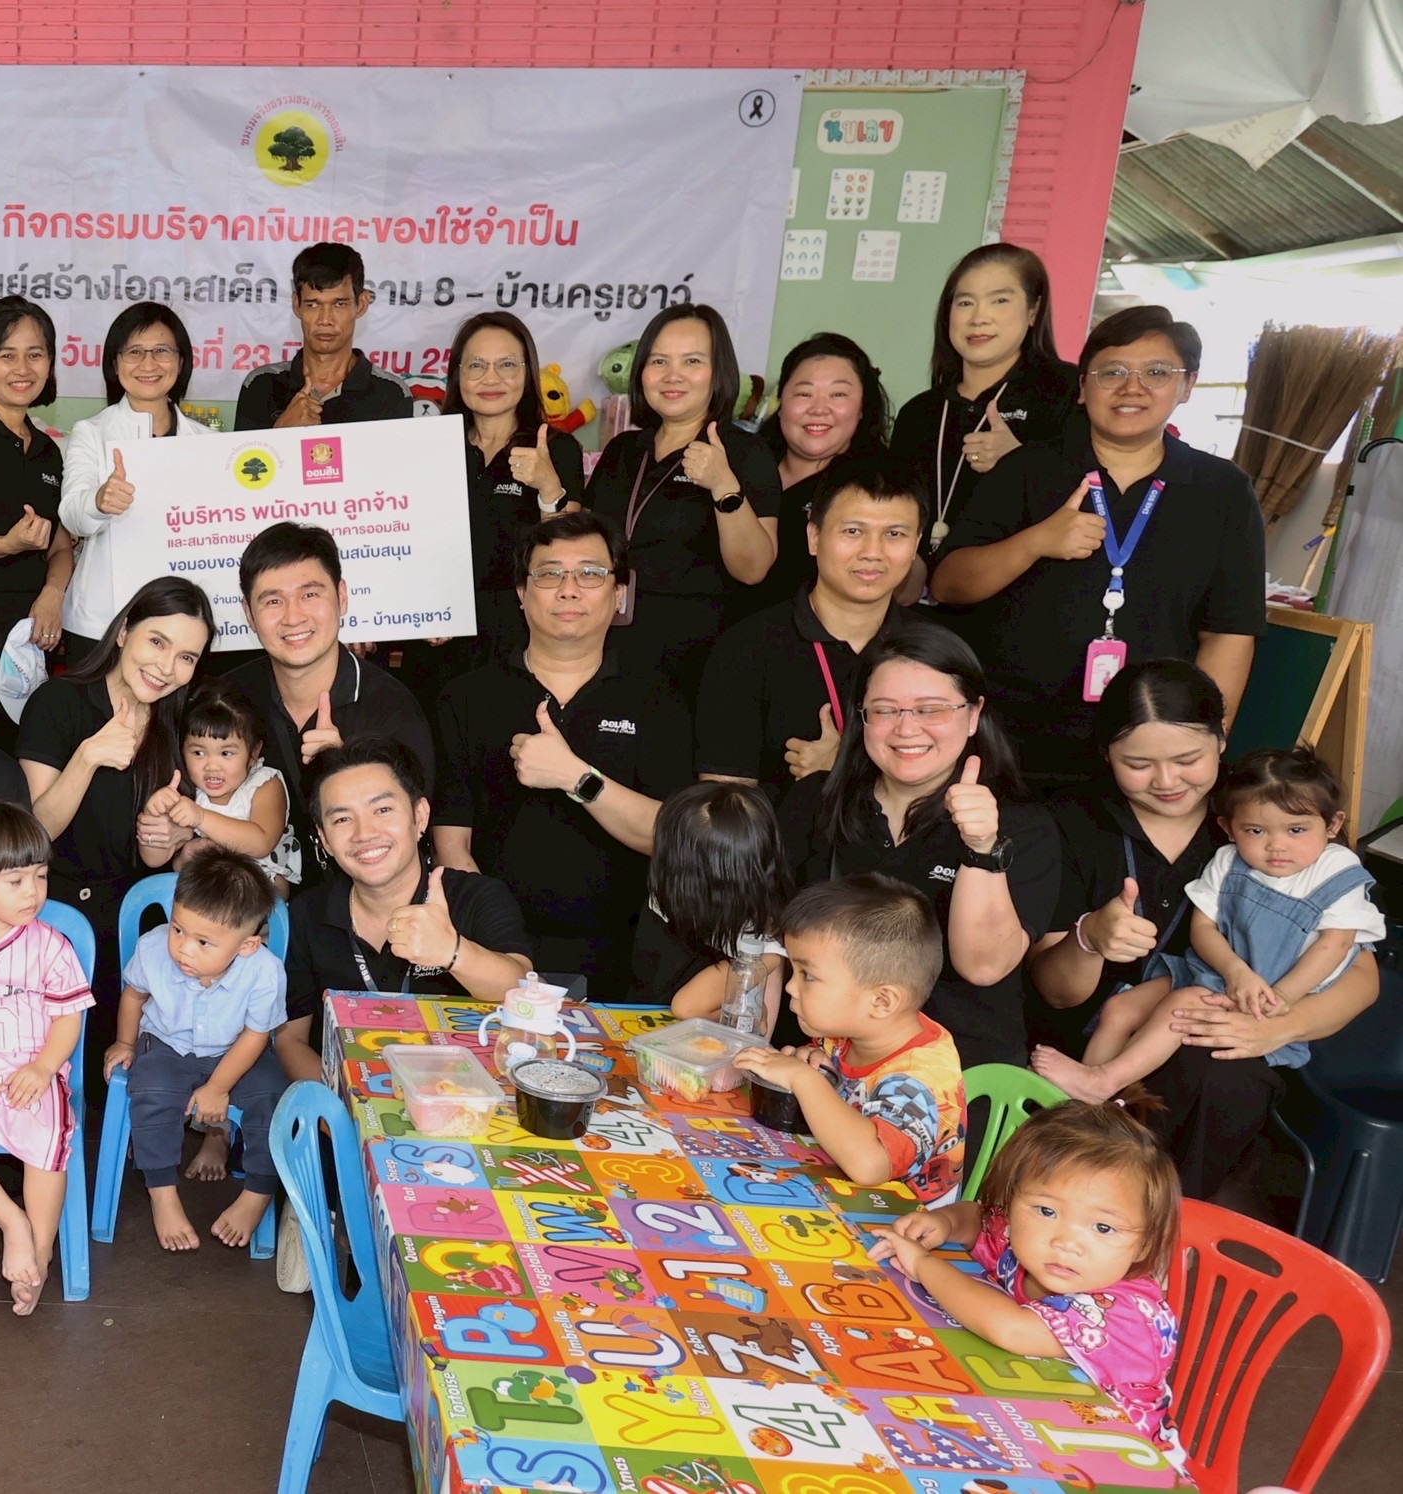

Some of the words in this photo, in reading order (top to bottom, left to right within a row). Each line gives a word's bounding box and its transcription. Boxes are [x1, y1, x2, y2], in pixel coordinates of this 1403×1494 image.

[2, 204, 579, 246] กิจกรรมบริจาคเงินและของใช้จำเป็น
[433, 277, 455, 307] 8
[496, 271, 696, 322] บ้านครูเชาว์
[232, 344, 271, 370] 23
[306, 466, 339, 477] ออมสิน
[166, 505, 245, 533] ผู้บริหาร
[252, 499, 336, 520] พนักงาน
[343, 491, 409, 520] ลูกจ้าง
[351, 586, 371, 596] บาท
[349, 616, 358, 627] 8
[373, 606, 452, 628] บ้านครูเชาว์
[601, 719, 635, 730] ออมสิน
[387, 1158, 402, 1183] Sheep
[481, 1148, 497, 1169] Xmas
[697, 1160, 717, 1180] Dog
[403, 1186, 418, 1202] Rat
[867, 1192, 890, 1210] Ice
[402, 1236, 420, 1264] Queen
[519, 1242, 553, 1295] Vegetable
[768, 1261, 795, 1289] Bear
[425, 1294, 447, 1332] Penguin
[559, 1308, 586, 1358] Umbrella
[682, 1326, 711, 1358] Zebra
[807, 1321, 844, 1358] Apple
[439, 1370, 470, 1421] Tortoise
[685, 1378, 716, 1419] Yellow
[732, 1401, 847, 1449] 4
[995, 1399, 1043, 1446] Jaguar
[975, 1410, 1033, 1470] Elephant
[611, 1455, 635, 1494] Xmas
